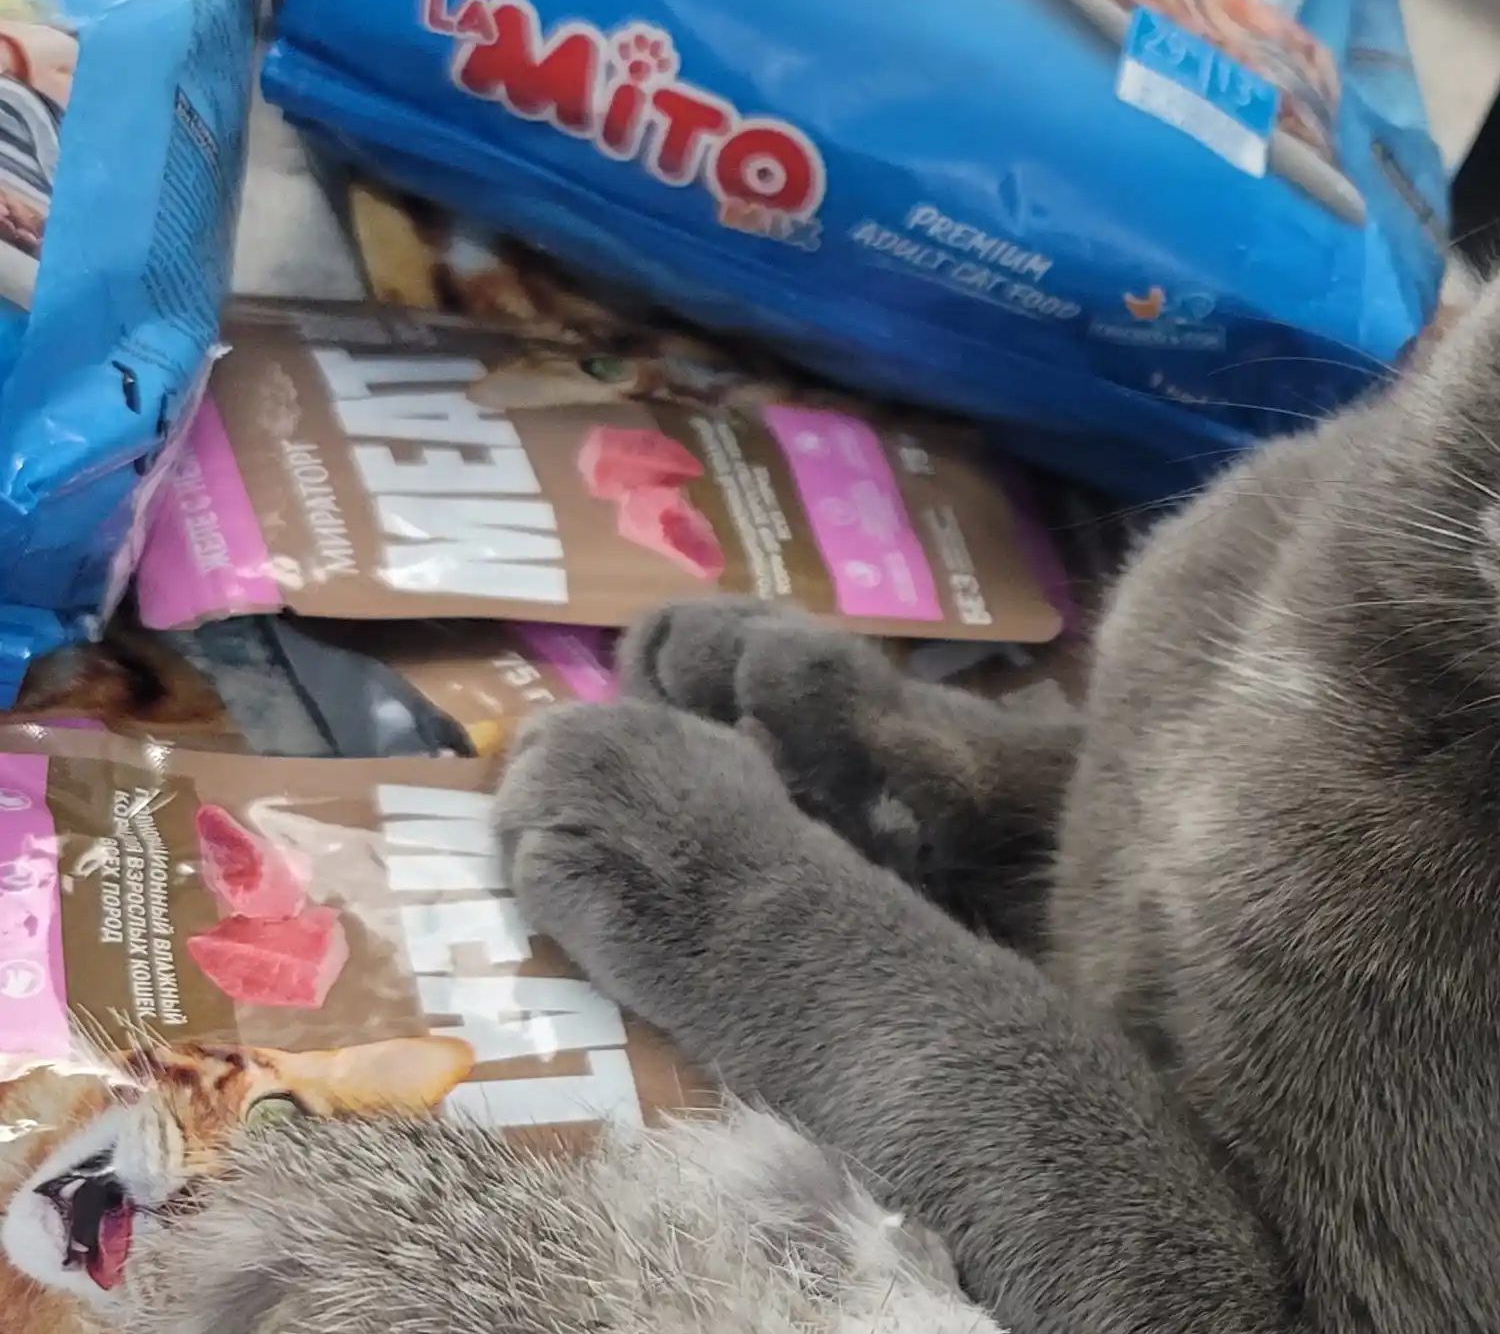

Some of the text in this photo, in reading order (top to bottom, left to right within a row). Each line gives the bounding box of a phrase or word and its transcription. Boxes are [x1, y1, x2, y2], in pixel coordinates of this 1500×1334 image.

[851, 220, 952, 270] ADULT
[1007, 282, 1081, 319] FOOD
[907, 205, 1052, 282] PREMIUM
[282, 440, 359, 576] МИРАТОРГ
[311, 347, 568, 604] MEAT
[101, 881, 123, 943] ПОРОД
[126, 854, 148, 956] ВЗРОСЛЫХ
[130, 958, 157, 1019] КОШЕК
[154, 939, 188, 1025] ВЛАЖНЫЙ
